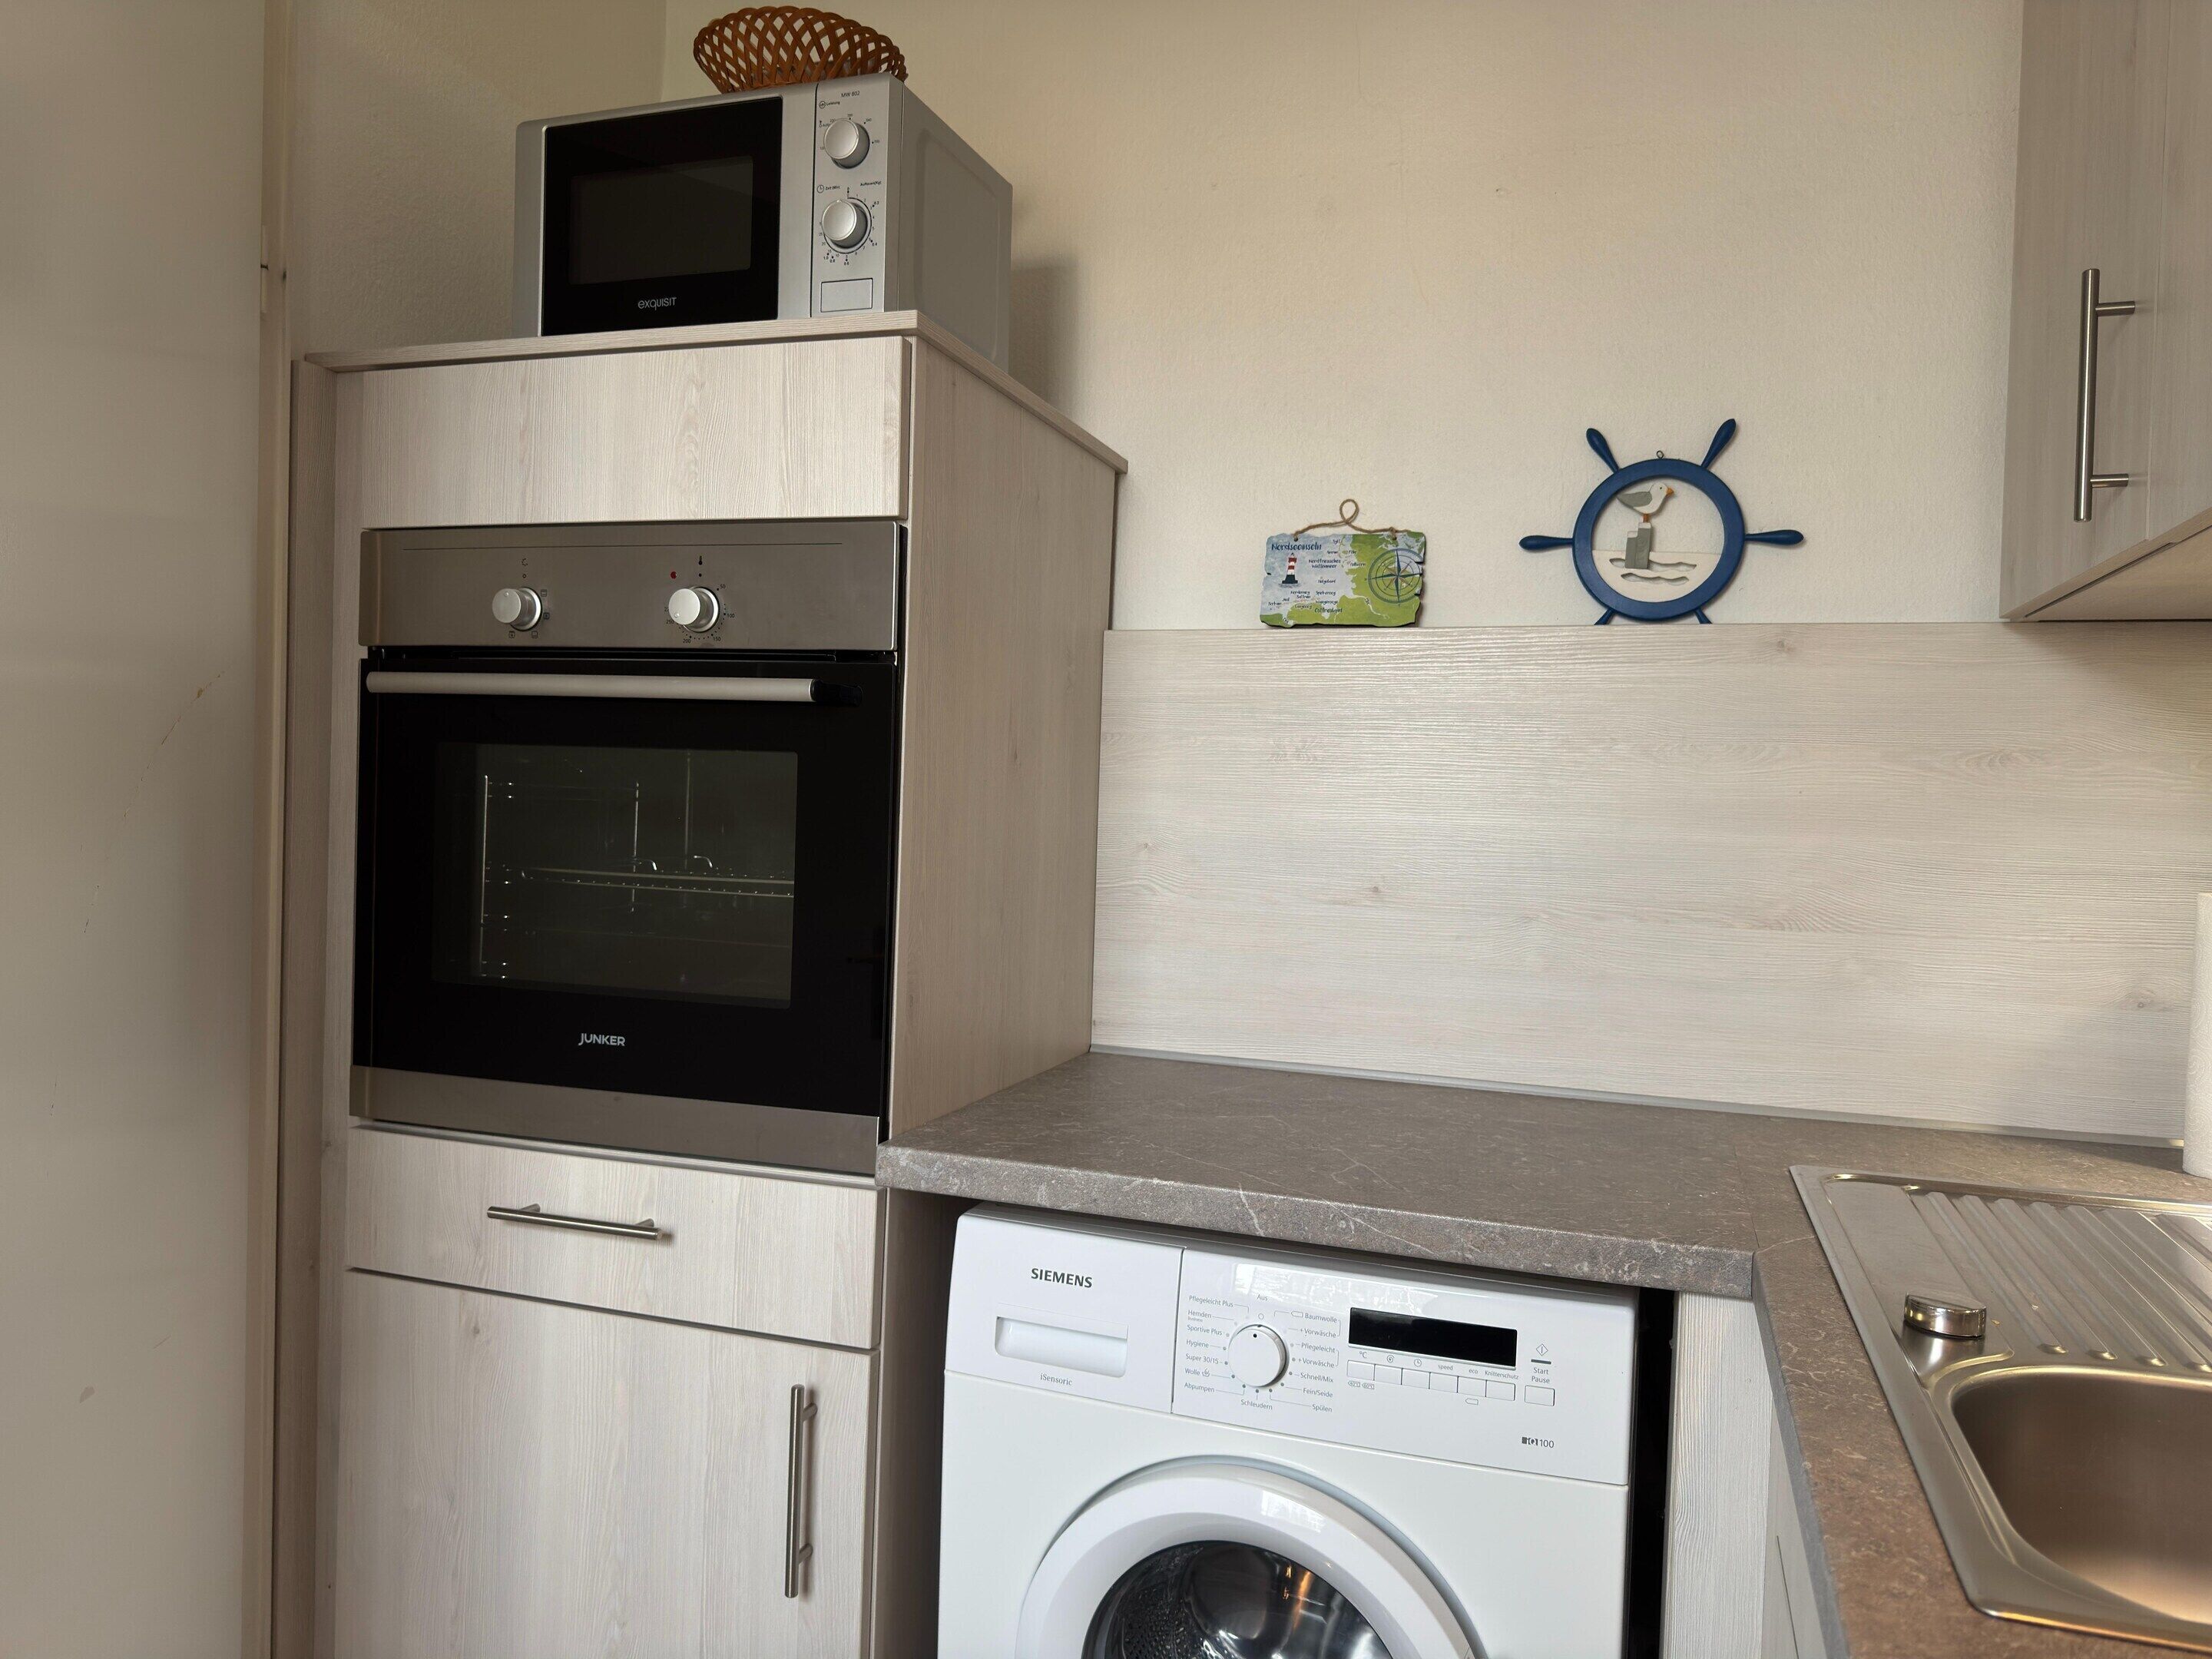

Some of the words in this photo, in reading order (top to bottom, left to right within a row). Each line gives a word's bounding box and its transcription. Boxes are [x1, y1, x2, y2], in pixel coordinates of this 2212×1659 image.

[578, 1032, 626, 1046] JUNKER
[1031, 1267, 1093, 1288] SIEMENS
[1189, 1295, 1221, 1306] Pflegeleicht
[1187, 1310, 1211, 1318] Hemden
[1305, 1312, 1337, 1323] Baumwolle
[1187, 1324, 1210, 1333] Sportive
[1186, 1339, 1209, 1348] Hygiene
[1301, 1343, 1336, 1353] Pflegeleicht
[1185, 1353, 1201, 1362] Super
[1203, 1356, 1219, 1364] 30/15
[1040, 1373, 1073, 1386] iSensoric
[1300, 1372, 1334, 1382] Schnell/Mix
[1484, 1370, 1519, 1380] Knitterschutz
[1184, 1382, 1215, 1392] Abpumpen
[1303, 1387, 1333, 1398] Fein/Seide
[1240, 1399, 1273, 1410] Schleudern
[1312, 1404, 1333, 1412] Spülen
